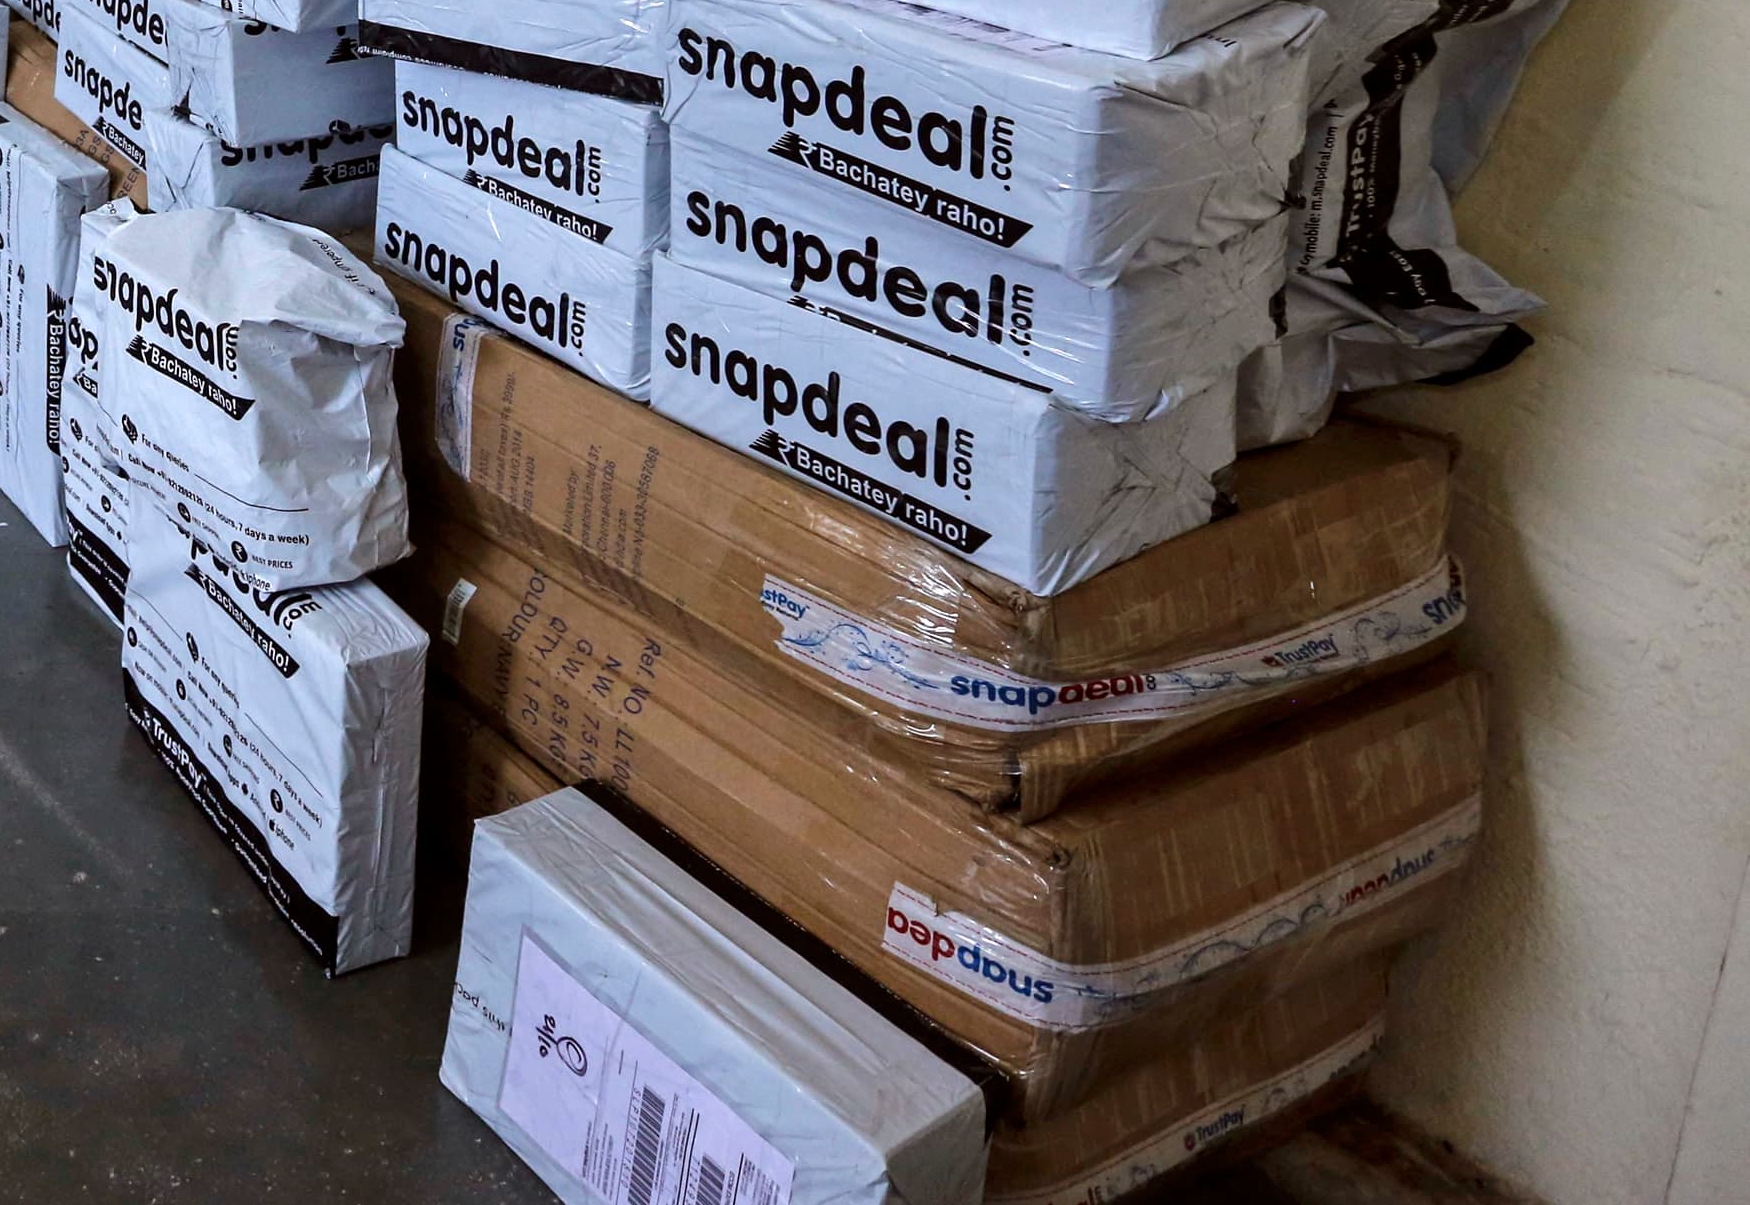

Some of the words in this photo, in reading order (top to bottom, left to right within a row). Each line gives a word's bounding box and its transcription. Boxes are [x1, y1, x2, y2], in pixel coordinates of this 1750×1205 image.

[678, 26, 987, 181] snapdeal
[403, 91, 585, 196] snapdeal
[488, 181, 552, 222] Bachatey
[555, 209, 598, 240] raho!
[819, 146, 927, 211] Bachatey
[934, 193, 1006, 241] raho!
[385, 221, 568, 347] snapdeal
[687, 191, 1004, 346] snapdeal
[94, 256, 230, 371] snapdeal
[49, 324, 64, 400] Bachatey
[151, 350, 206, 395] Bachatey
[207, 386, 238, 416] raho!
[48, 400, 61, 444] raho!
[664, 321, 951, 488] snapdeal
[166, 448, 189, 473] queries
[795, 444, 897, 517] Bachatey
[904, 498, 969, 547] raho!
[245, 527, 267, 543] days
[268, 534, 275, 542] a
[278, 534, 310, 546] week)
[267, 559, 293, 569] PRICES
[208, 580, 255, 639] Bachatey
[257, 635, 290, 673] raho!
[1276, 636, 1339, 664] TrustPay
[152, 716, 204, 790] TrustPay
[1196, 1106, 1245, 1144] TrustPay
